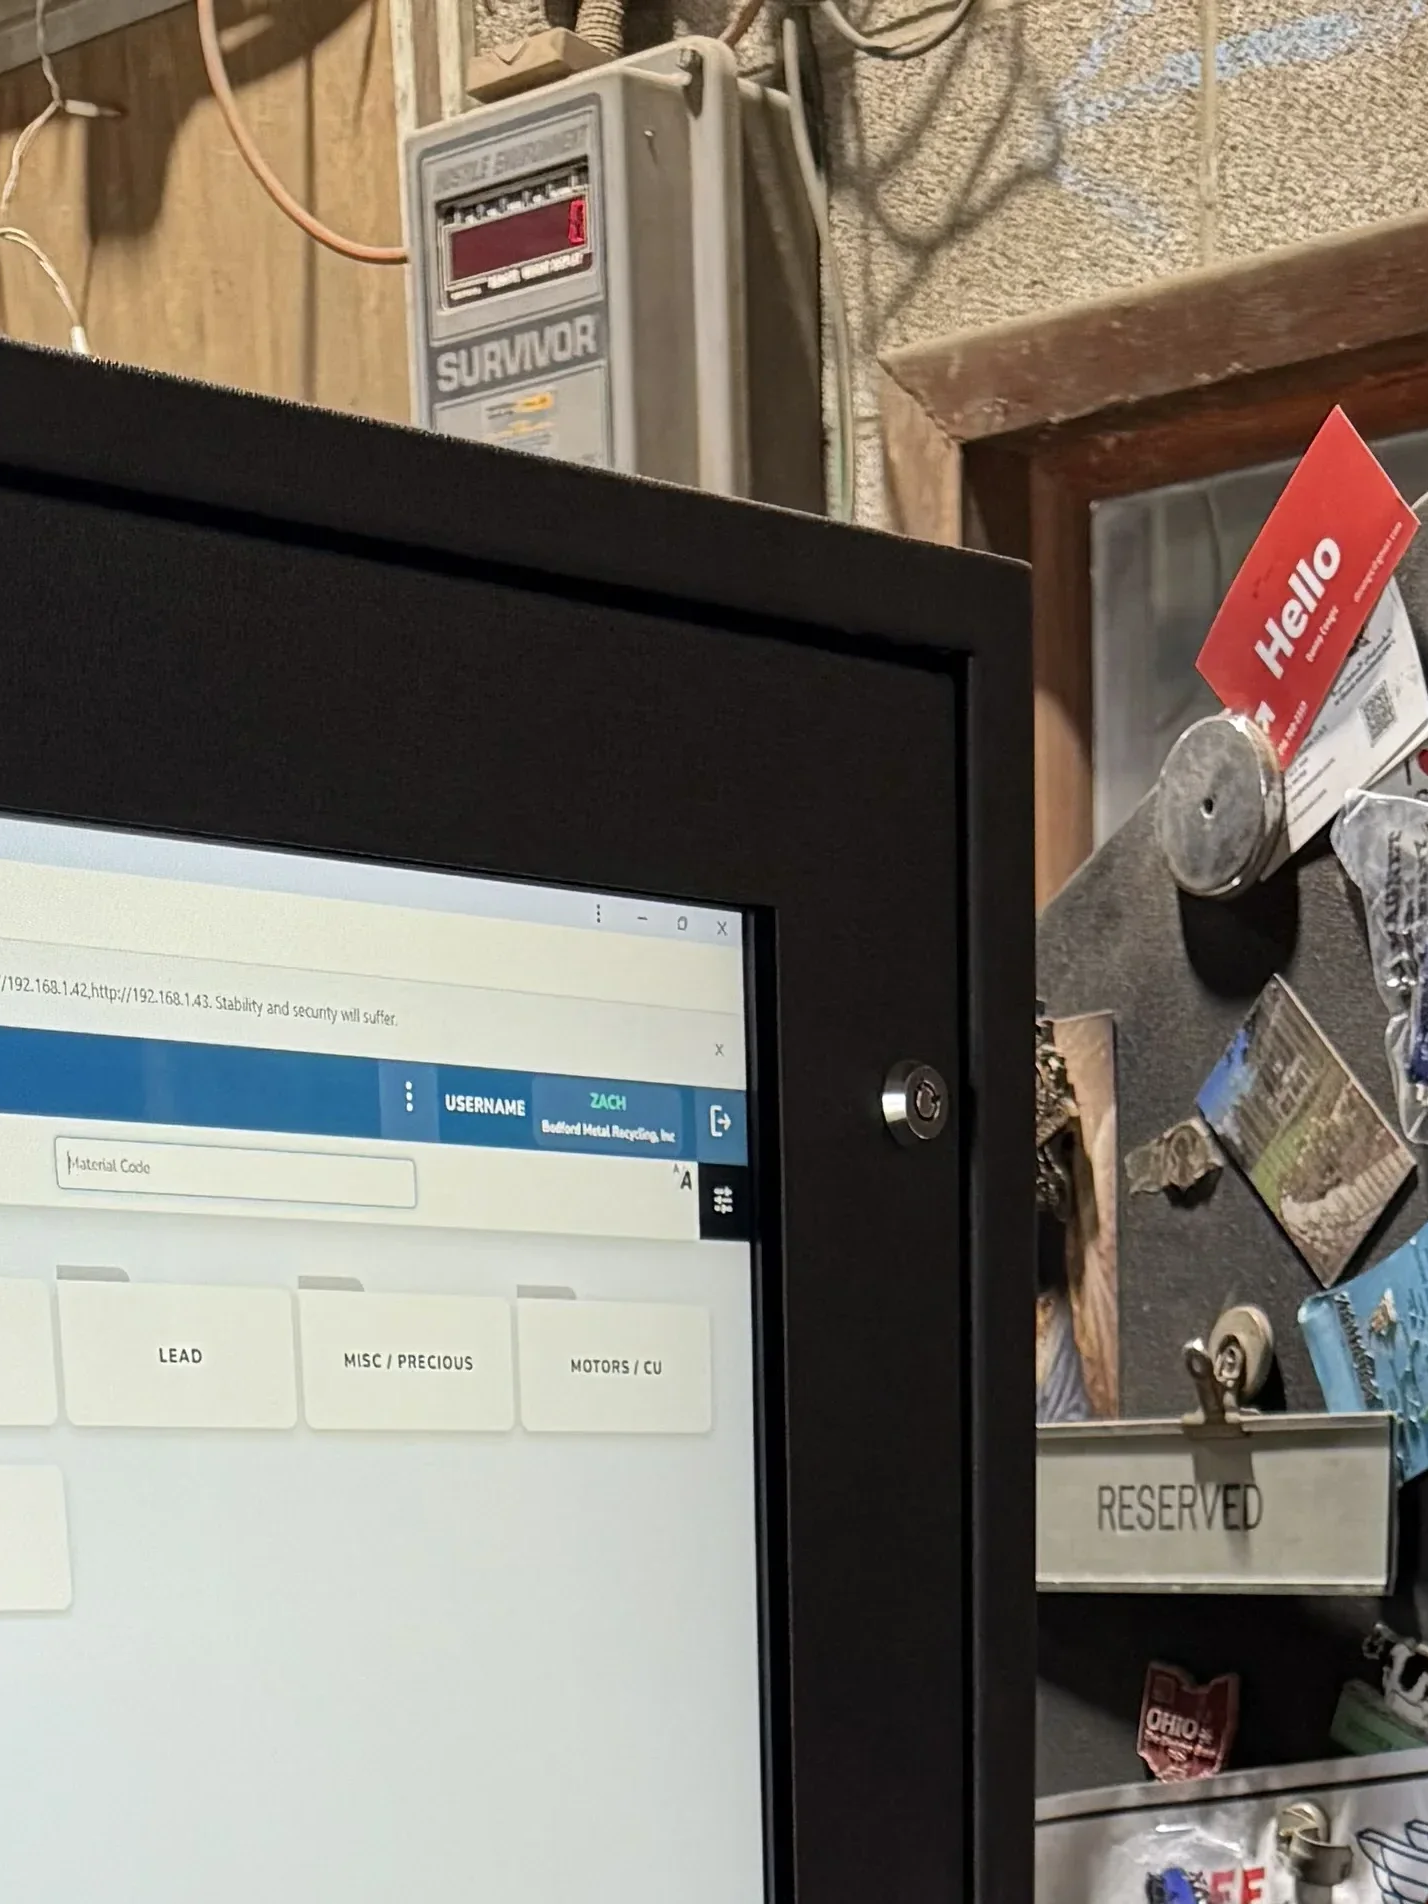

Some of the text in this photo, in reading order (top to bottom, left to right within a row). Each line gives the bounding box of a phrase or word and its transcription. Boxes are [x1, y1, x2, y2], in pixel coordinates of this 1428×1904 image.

[436, 313, 597, 392] SURVIVOR
[1255, 538, 1340, 679] Hello
[216, 995, 263, 1017] Stability
[267, 1002, 289, 1017] and
[293, 1006, 337, 1025] security
[341, 1008, 360, 1023] will
[363, 1010, 398, 1027] suffer.
[445, 1094, 526, 1117] USERNAME
[589, 1092, 626, 1111] ZACH
[541, 1120, 581, 1136] Bedford
[583, 1124, 610, 1138] Metal
[120, 1158, 151, 1174] Code
[158, 1345, 204, 1367] LEAD
[343, 1351, 384, 1371] MISC
[399, 1353, 474, 1373] PRECIOUS
[570, 1357, 625, 1377] MOTORS
[641, 1359, 663, 1378] CU
[1098, 1482, 1264, 1532] RESERVED
[1145, 1706, 1198, 1738] OHIO
